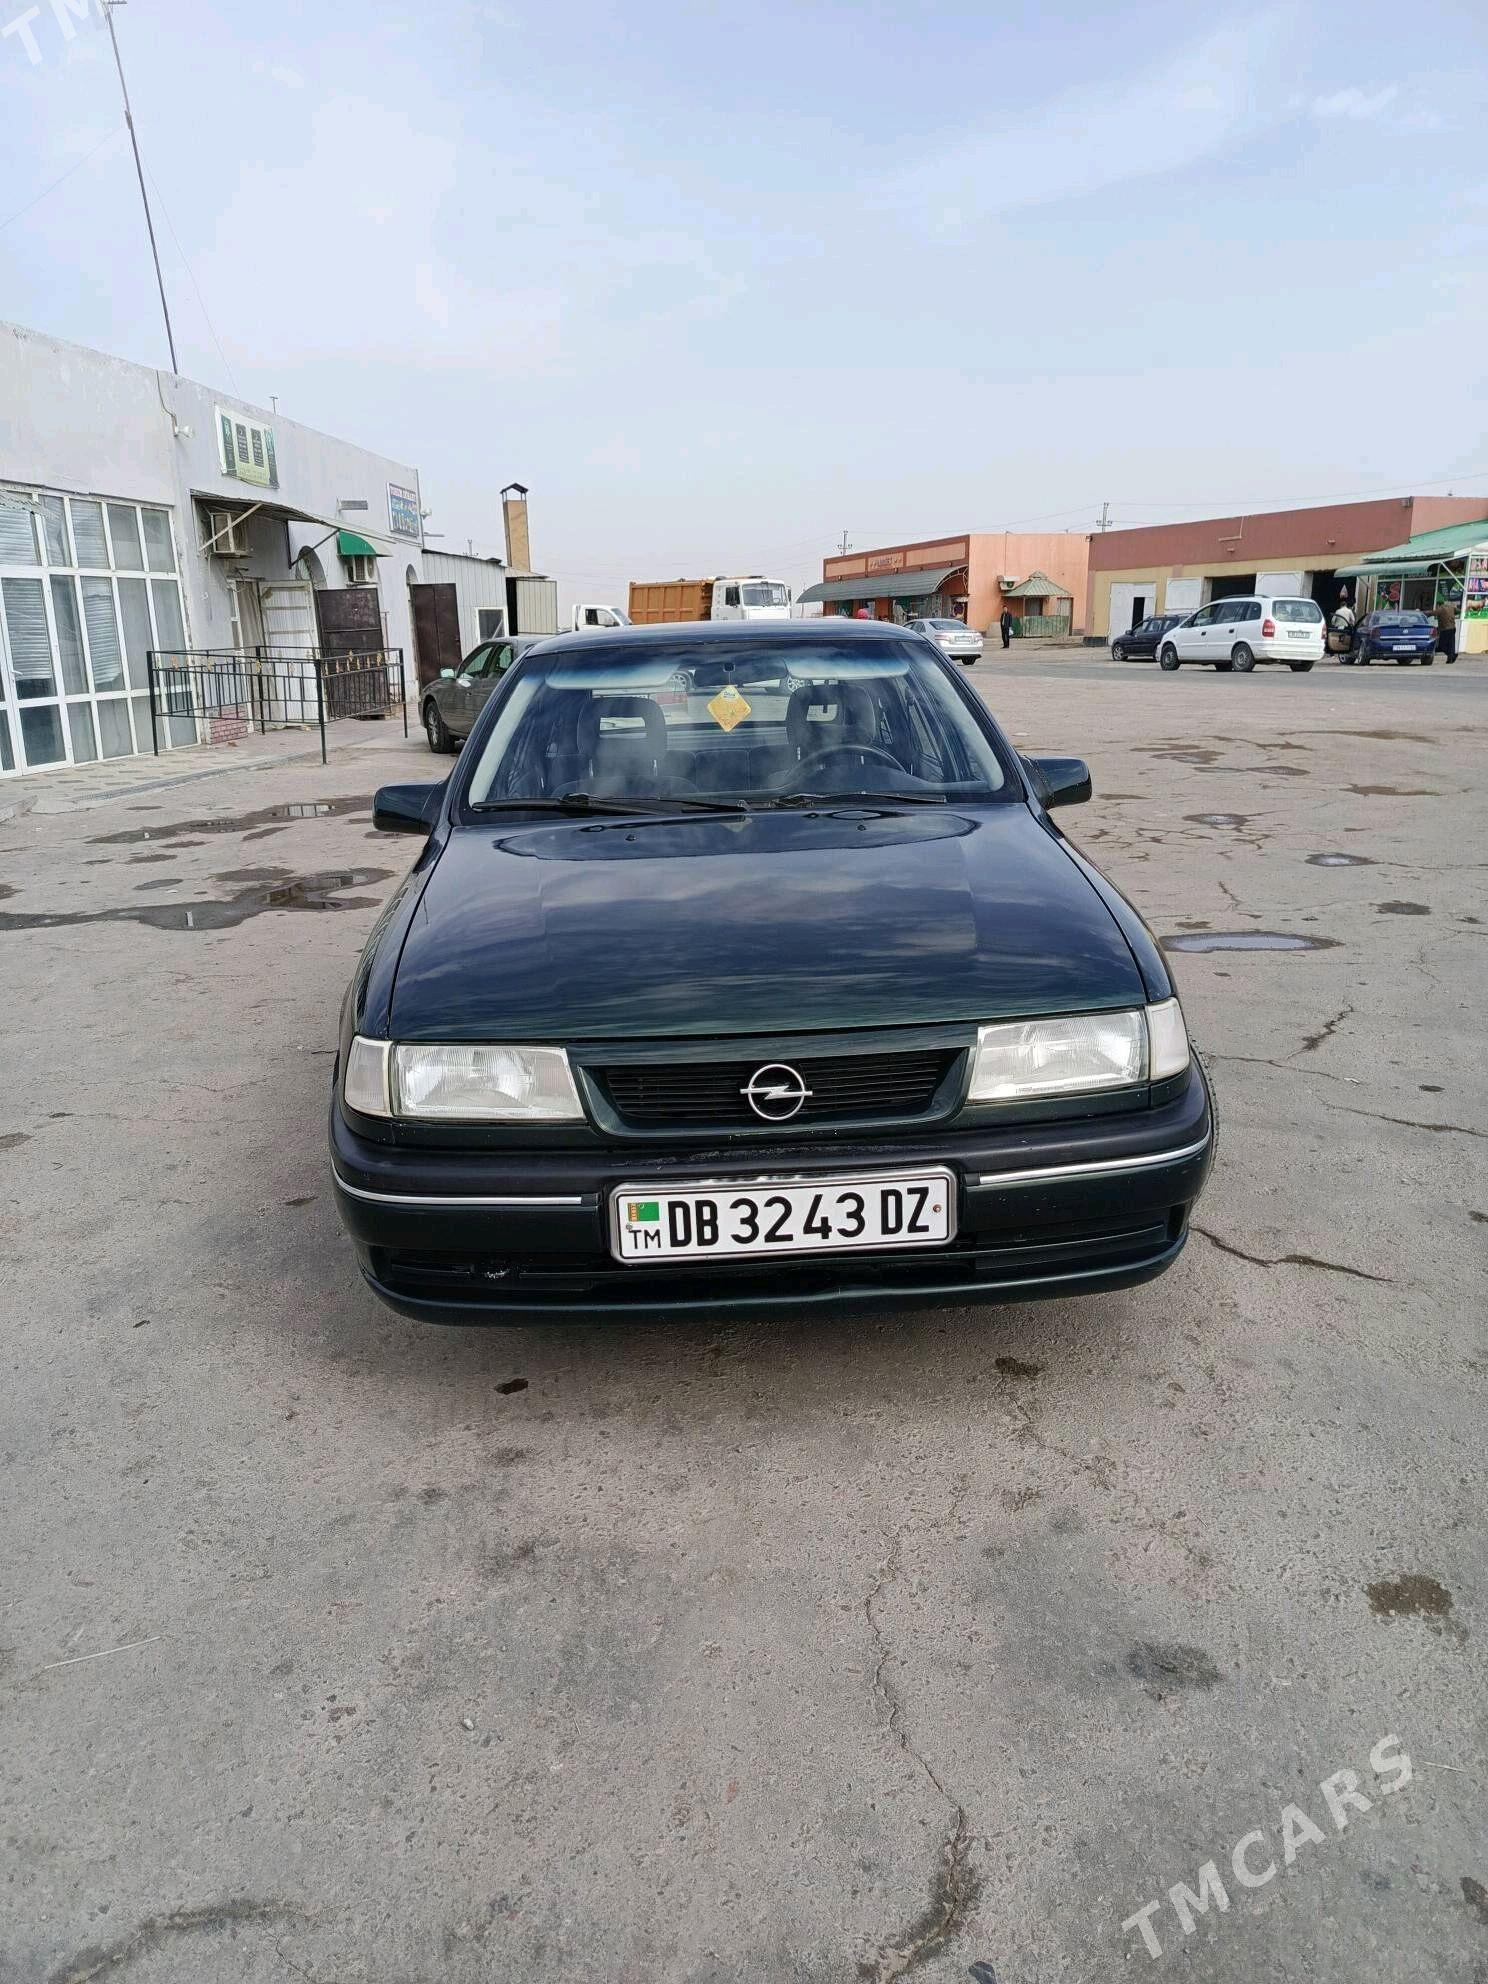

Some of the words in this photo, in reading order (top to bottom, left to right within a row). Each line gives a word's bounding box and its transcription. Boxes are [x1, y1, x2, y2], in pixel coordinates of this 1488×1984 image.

[631, 1228, 661, 1249] TM
[667, 1199, 719, 1248] DB
[880, 1187, 930, 1235] DZ
